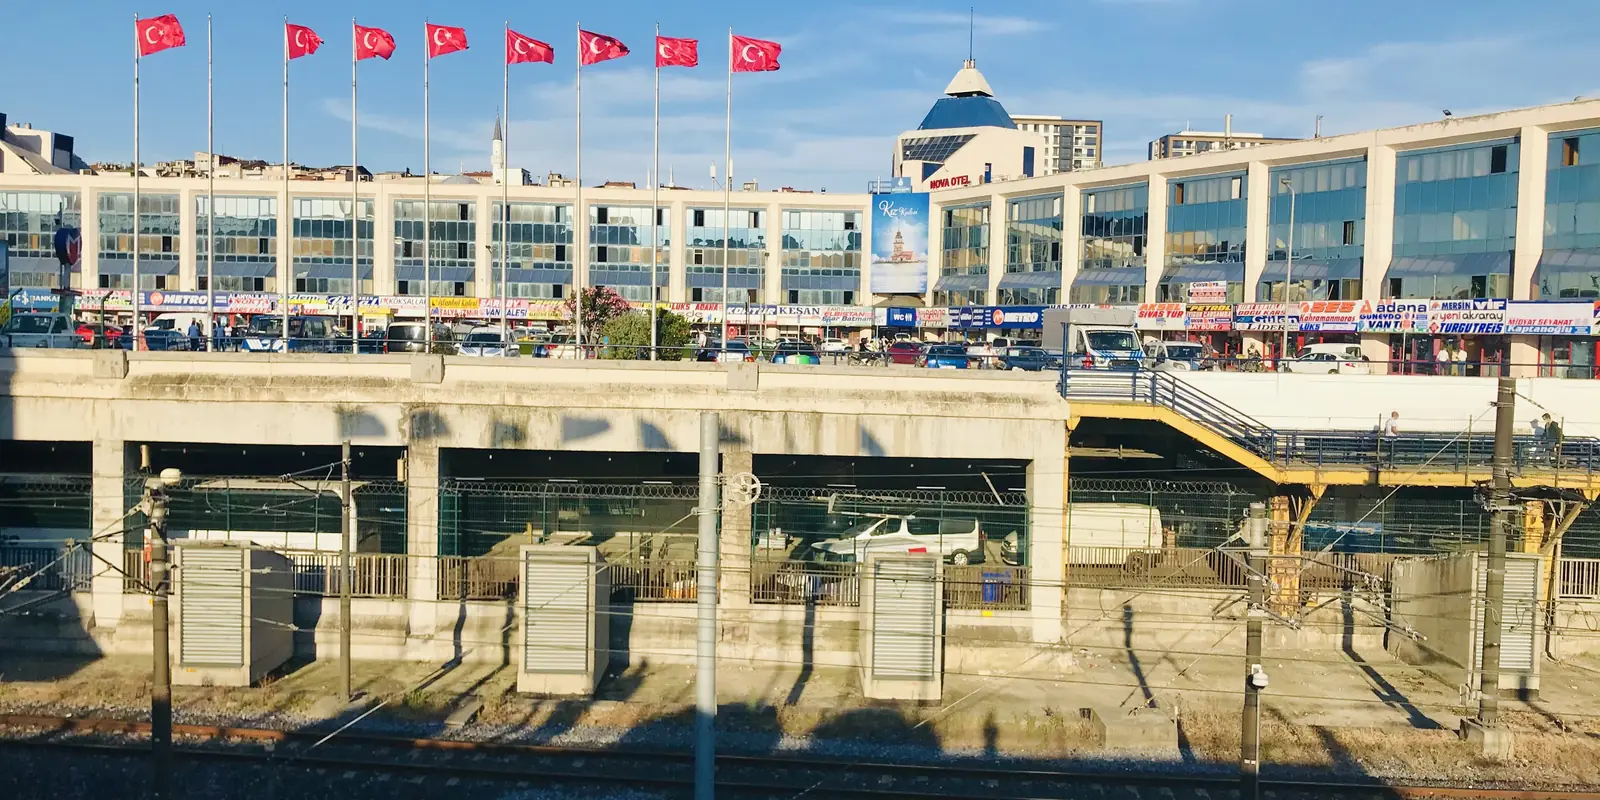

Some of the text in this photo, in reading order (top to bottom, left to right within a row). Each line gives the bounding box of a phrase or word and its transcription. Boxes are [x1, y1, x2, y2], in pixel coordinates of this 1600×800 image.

[930, 175, 971, 190] NOVA OTEL
[163, 294, 208, 305] METRO
[1310, 301, 1356, 313] SES
[1376, 302, 1427, 313] adana
[893, 313, 905, 321] WC
[1439, 311, 1461, 322] yeni
[1461, 310, 1504, 323] aksaray
[1368, 320, 1391, 329] VAN
